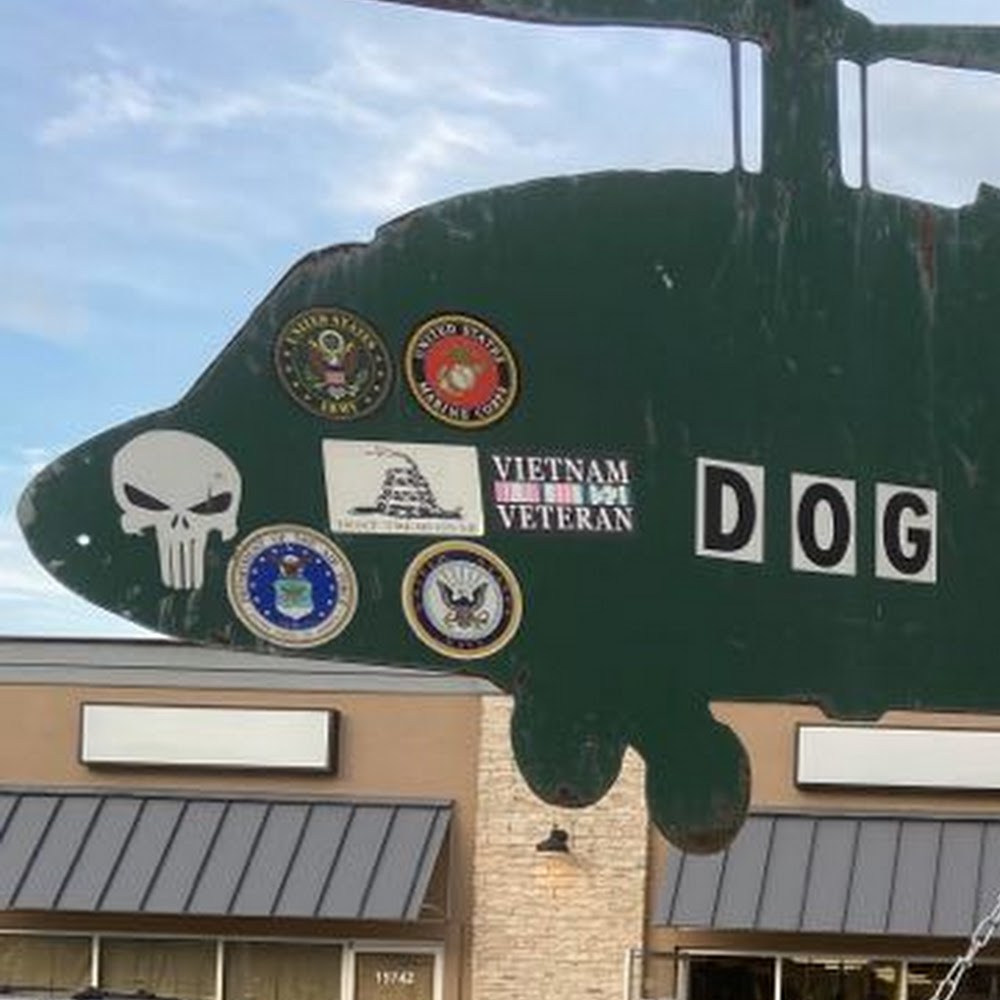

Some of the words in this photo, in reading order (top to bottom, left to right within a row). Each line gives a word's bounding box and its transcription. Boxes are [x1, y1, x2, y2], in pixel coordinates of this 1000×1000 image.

[492, 454, 630, 484] VIETNAM
[497, 505, 634, 532] VETERAN
[703, 465, 932, 575] DOG
